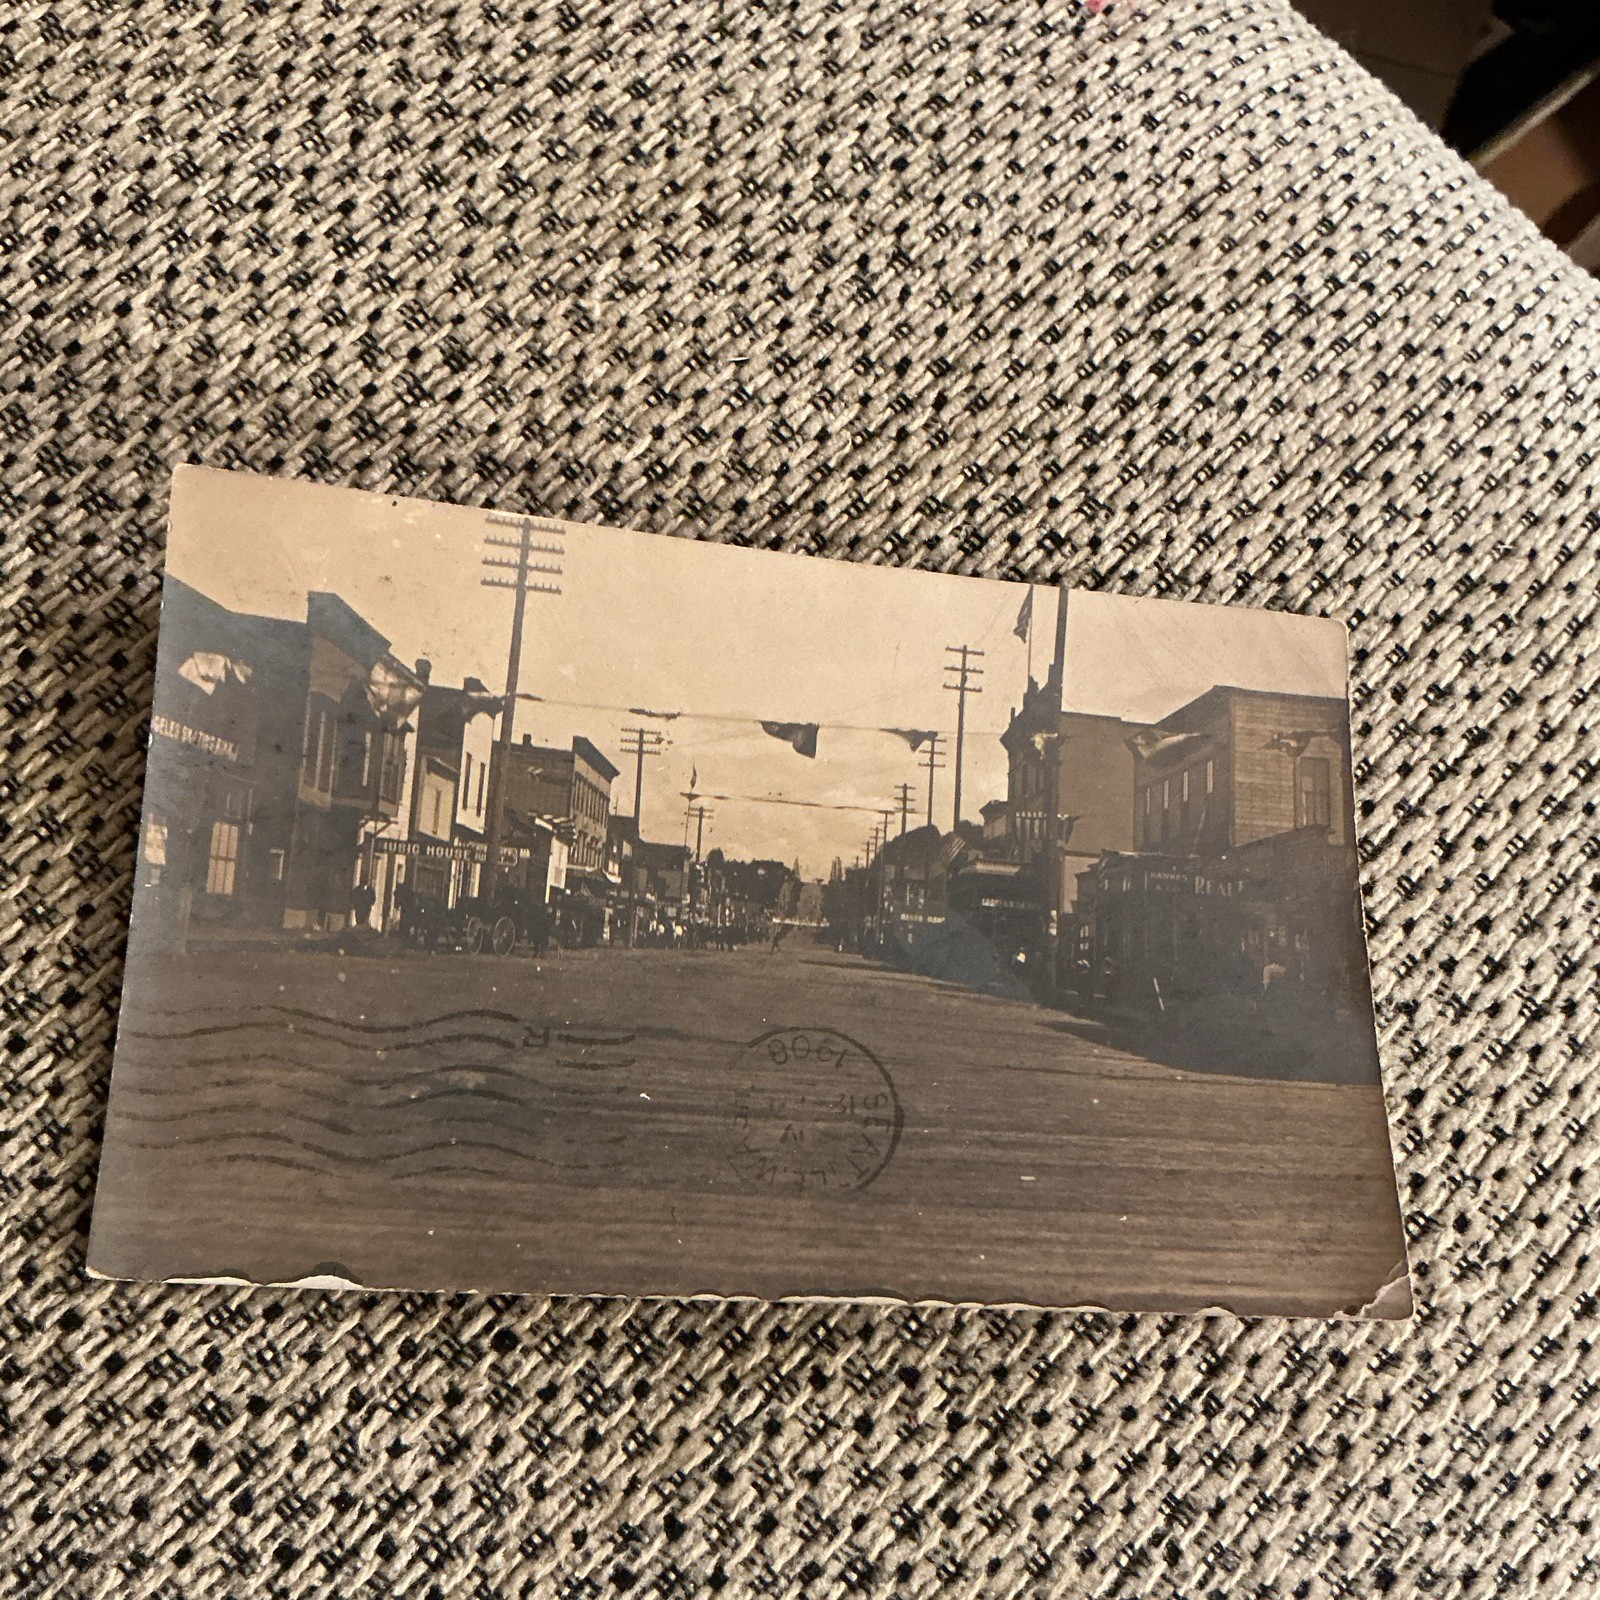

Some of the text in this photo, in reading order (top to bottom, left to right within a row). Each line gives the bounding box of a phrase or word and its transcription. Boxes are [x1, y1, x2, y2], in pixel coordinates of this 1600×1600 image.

[426, 844, 472, 861] HOUSE
[522, 1026, 550, 1049] R
[767, 1035, 848, 1069] 1908
